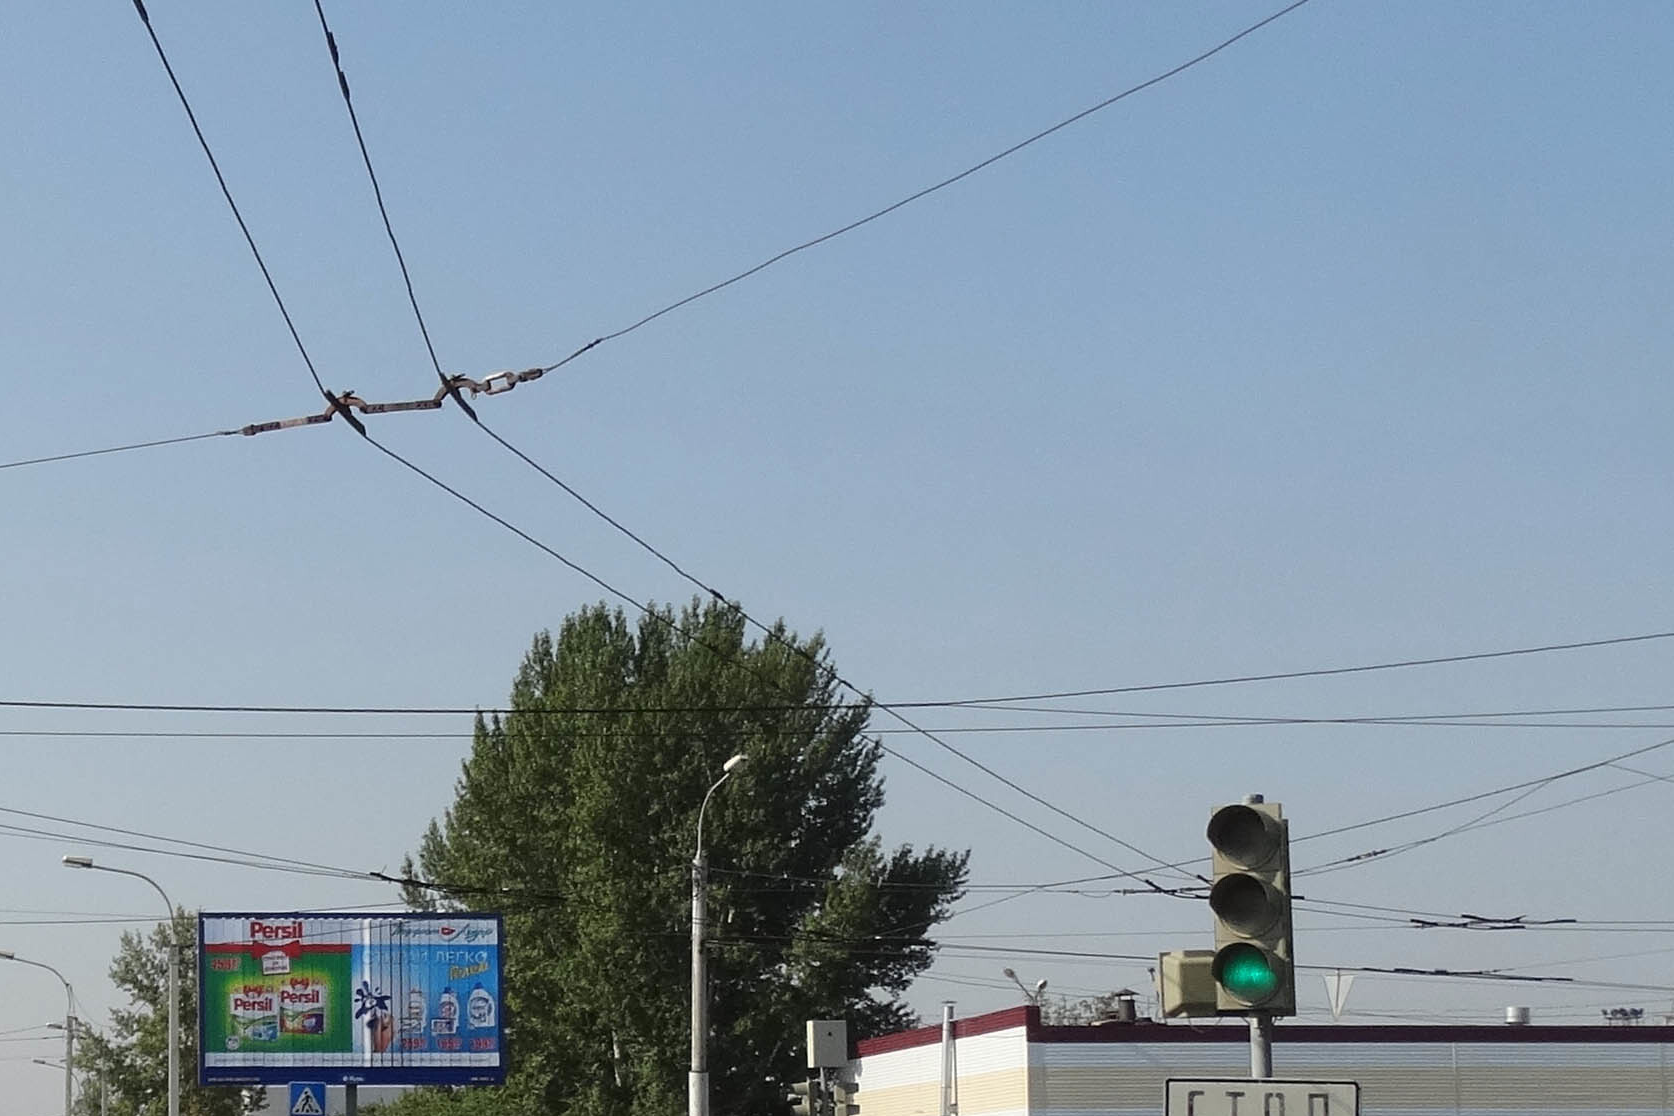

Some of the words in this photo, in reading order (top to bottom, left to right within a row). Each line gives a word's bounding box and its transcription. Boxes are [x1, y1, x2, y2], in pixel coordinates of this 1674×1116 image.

[250, 921, 303, 938] Persil
[281, 988, 319, 1003] Persil
[234, 997, 273, 1011] Persil
